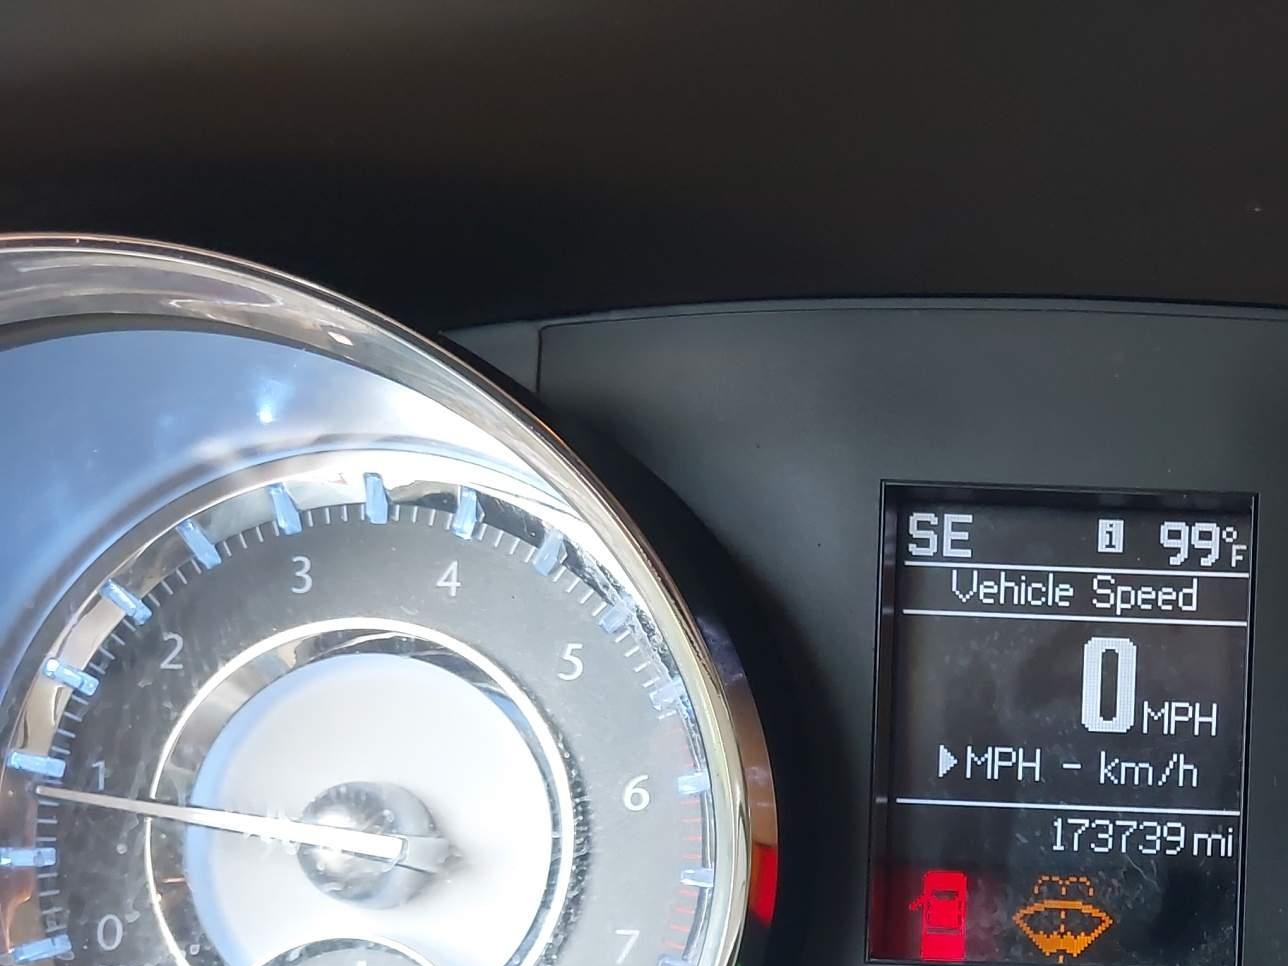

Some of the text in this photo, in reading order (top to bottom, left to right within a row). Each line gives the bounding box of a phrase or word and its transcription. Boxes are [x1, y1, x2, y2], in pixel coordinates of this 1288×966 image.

[908, 512, 973, 558] SE
[291, 556, 313, 594] 3
[435, 560, 461, 597] 4
[951, 569, 1199, 616] Vehicle Speed
[160, 632, 184, 670] 2
[558, 643, 584, 681] 5
[1081, 636, 1217, 737] 0 MPH
[92, 760, 105, 791] 1
[965, 745, 1041, 782] MPH
[1099, 750, 1199, 788] km/h
[623, 774, 650, 812] 6
[1052, 817, 1234, 858] 173739 mi
[97, 914, 123, 951] 0
[615, 929, 640, 965] 7
